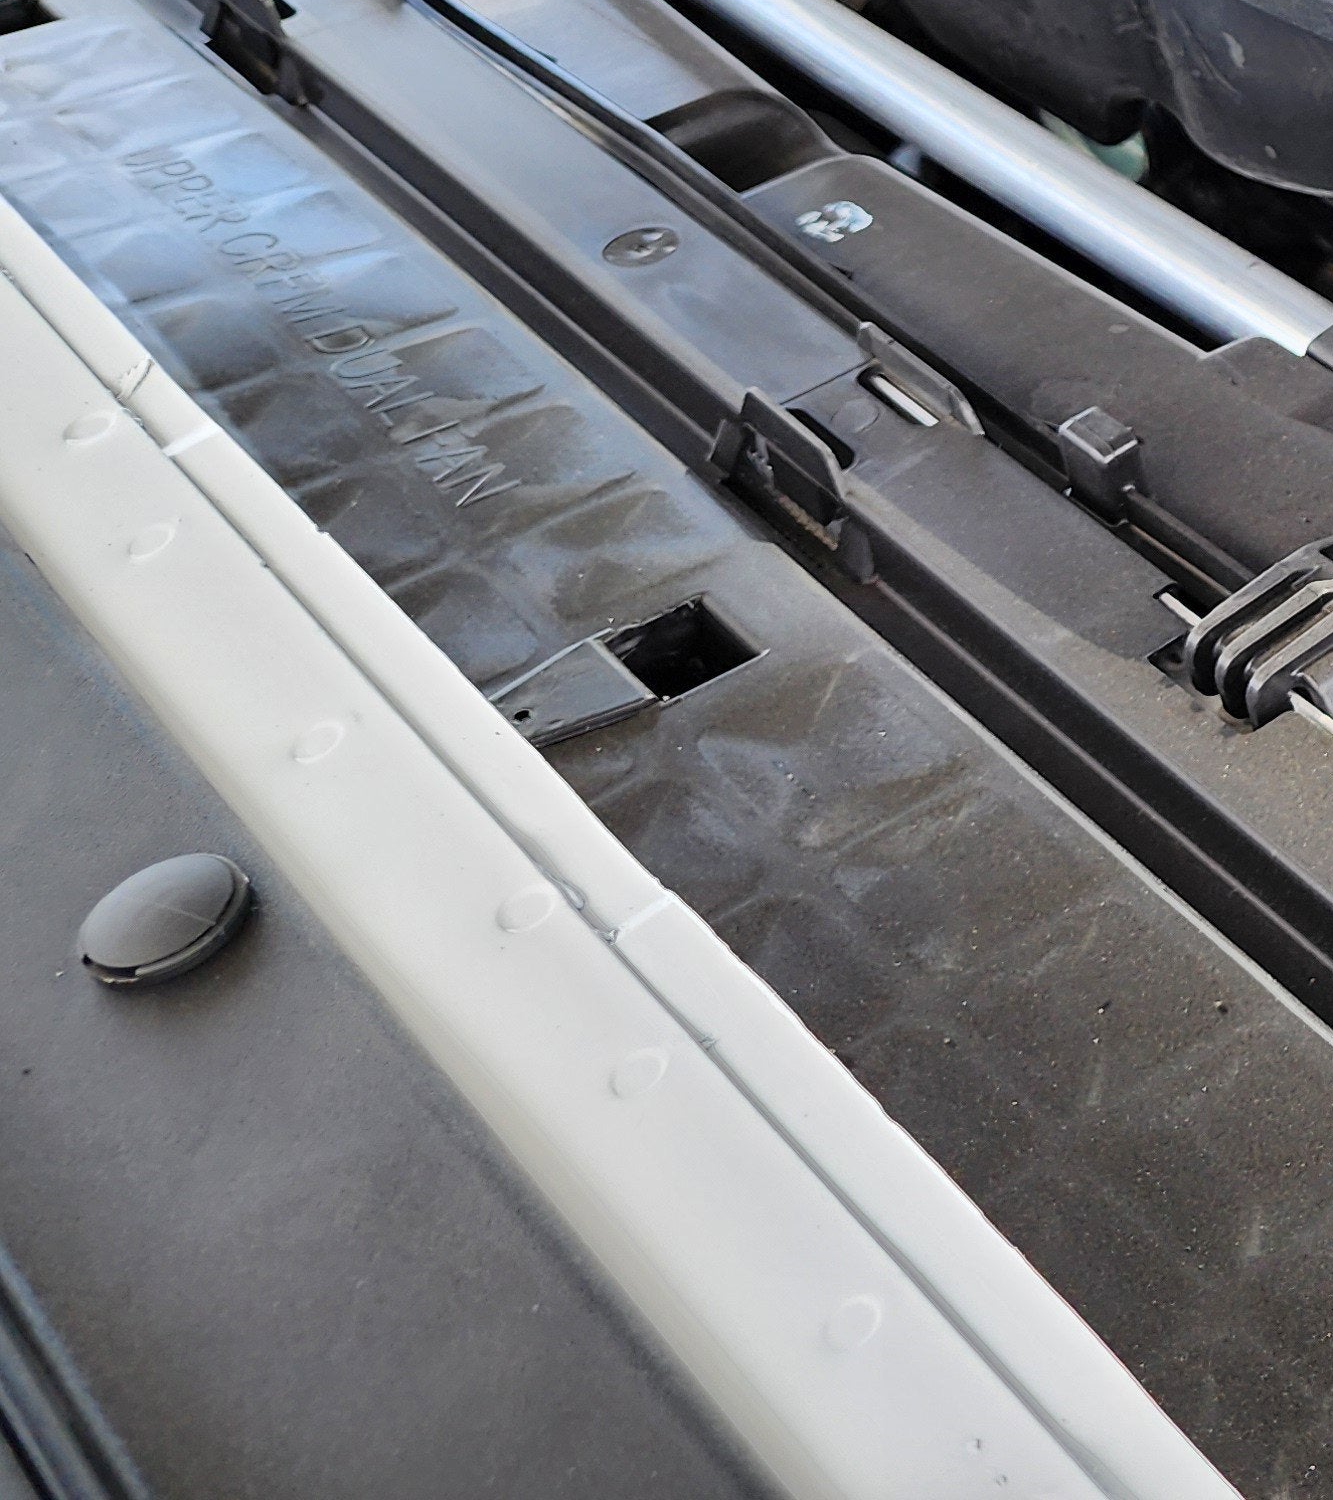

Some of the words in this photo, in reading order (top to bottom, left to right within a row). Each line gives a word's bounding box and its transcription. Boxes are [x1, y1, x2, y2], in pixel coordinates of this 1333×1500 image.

[120, 145, 251, 235] UPPER
[220, 231, 345, 334] CRFM
[309, 322, 441, 429] DUAL
[402, 418, 520, 508] FAN
